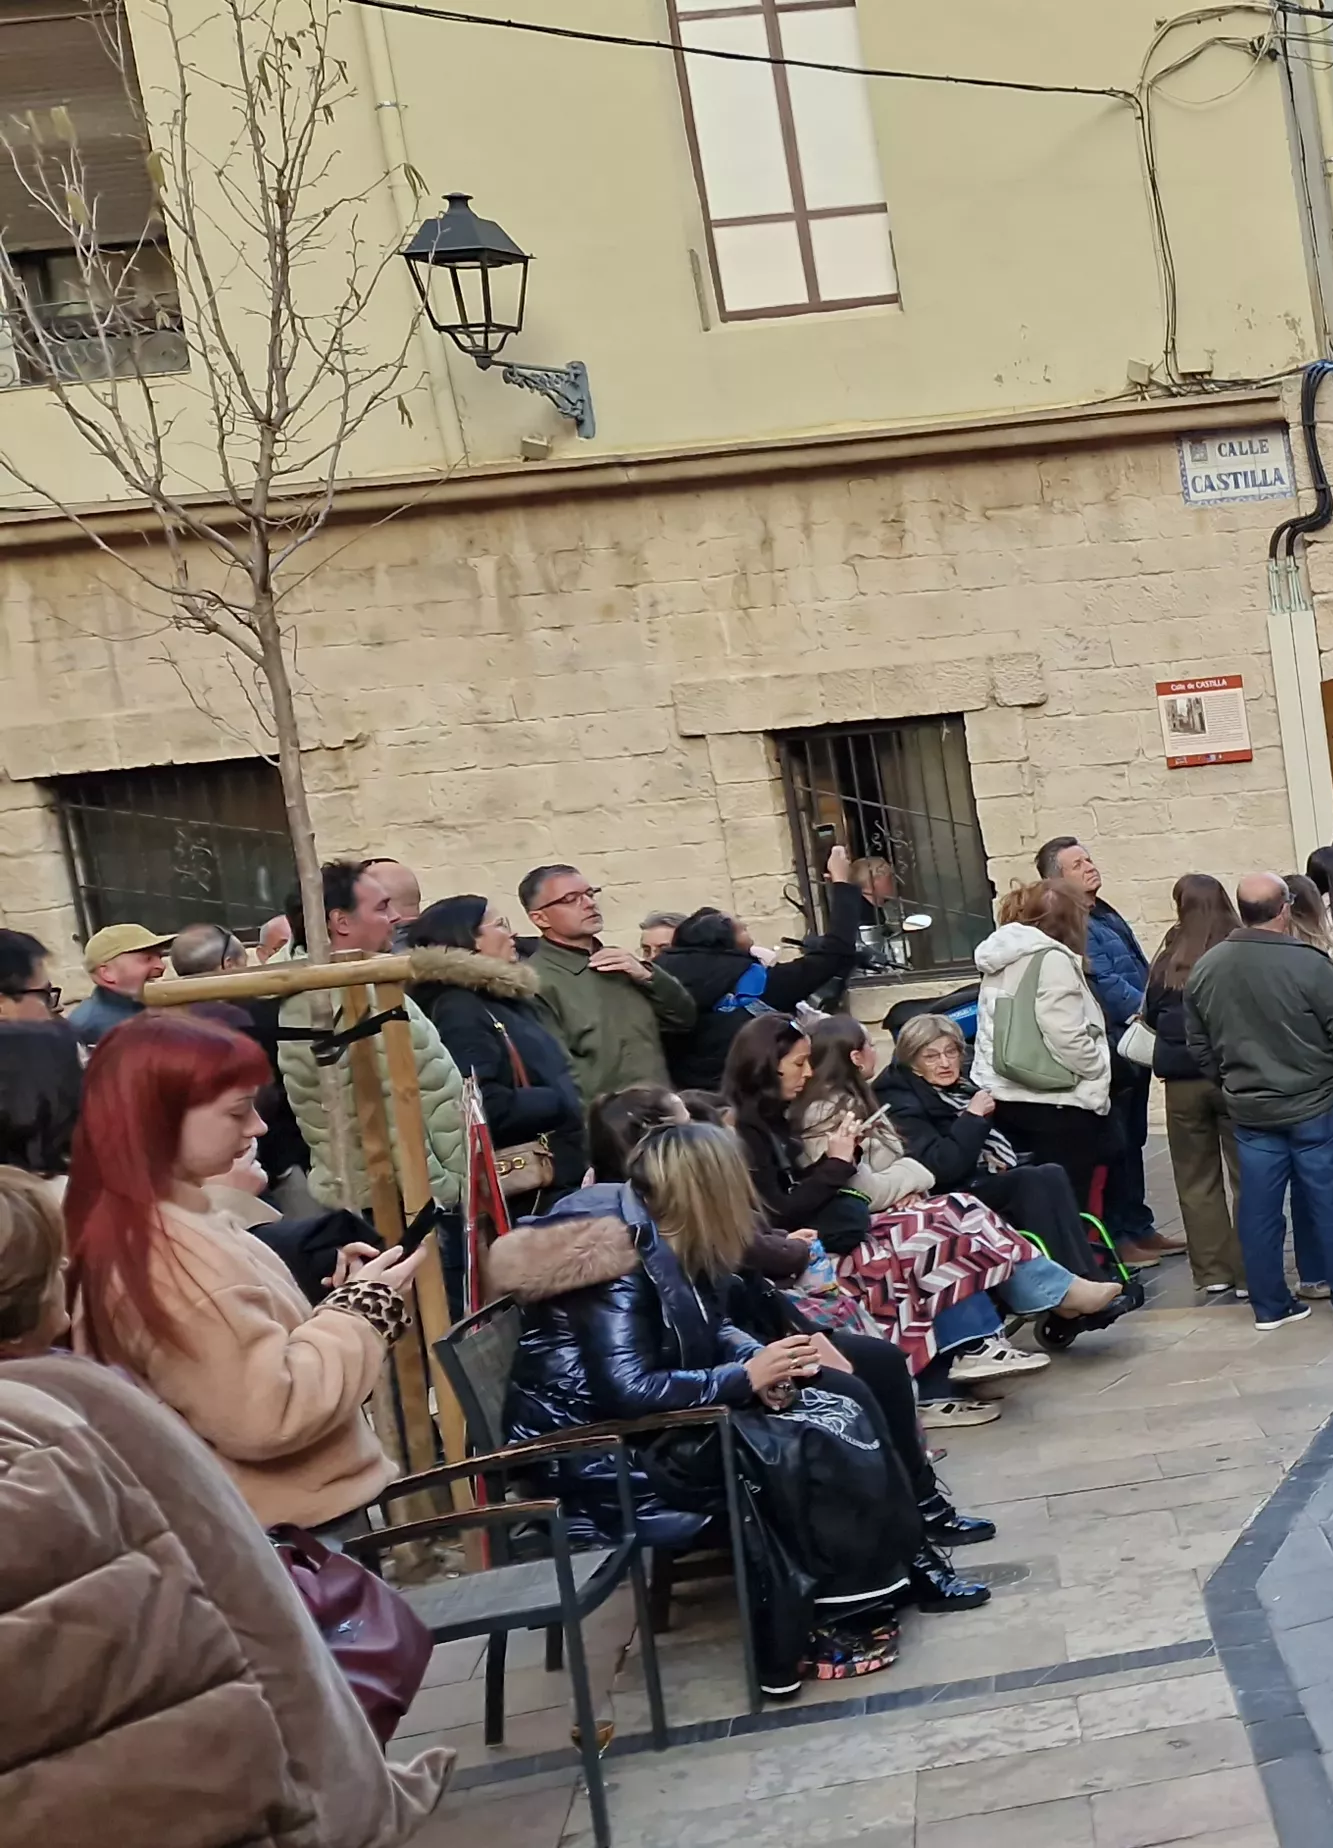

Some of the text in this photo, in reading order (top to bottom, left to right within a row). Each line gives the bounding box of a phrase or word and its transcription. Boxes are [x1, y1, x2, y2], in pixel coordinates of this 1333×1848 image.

[1217, 439, 1269, 457] CALLE
[1191, 467, 1285, 494] CASTILLA
[1187, 682, 1195, 690] de
[1195, 678, 1227, 689] CASTILLA
